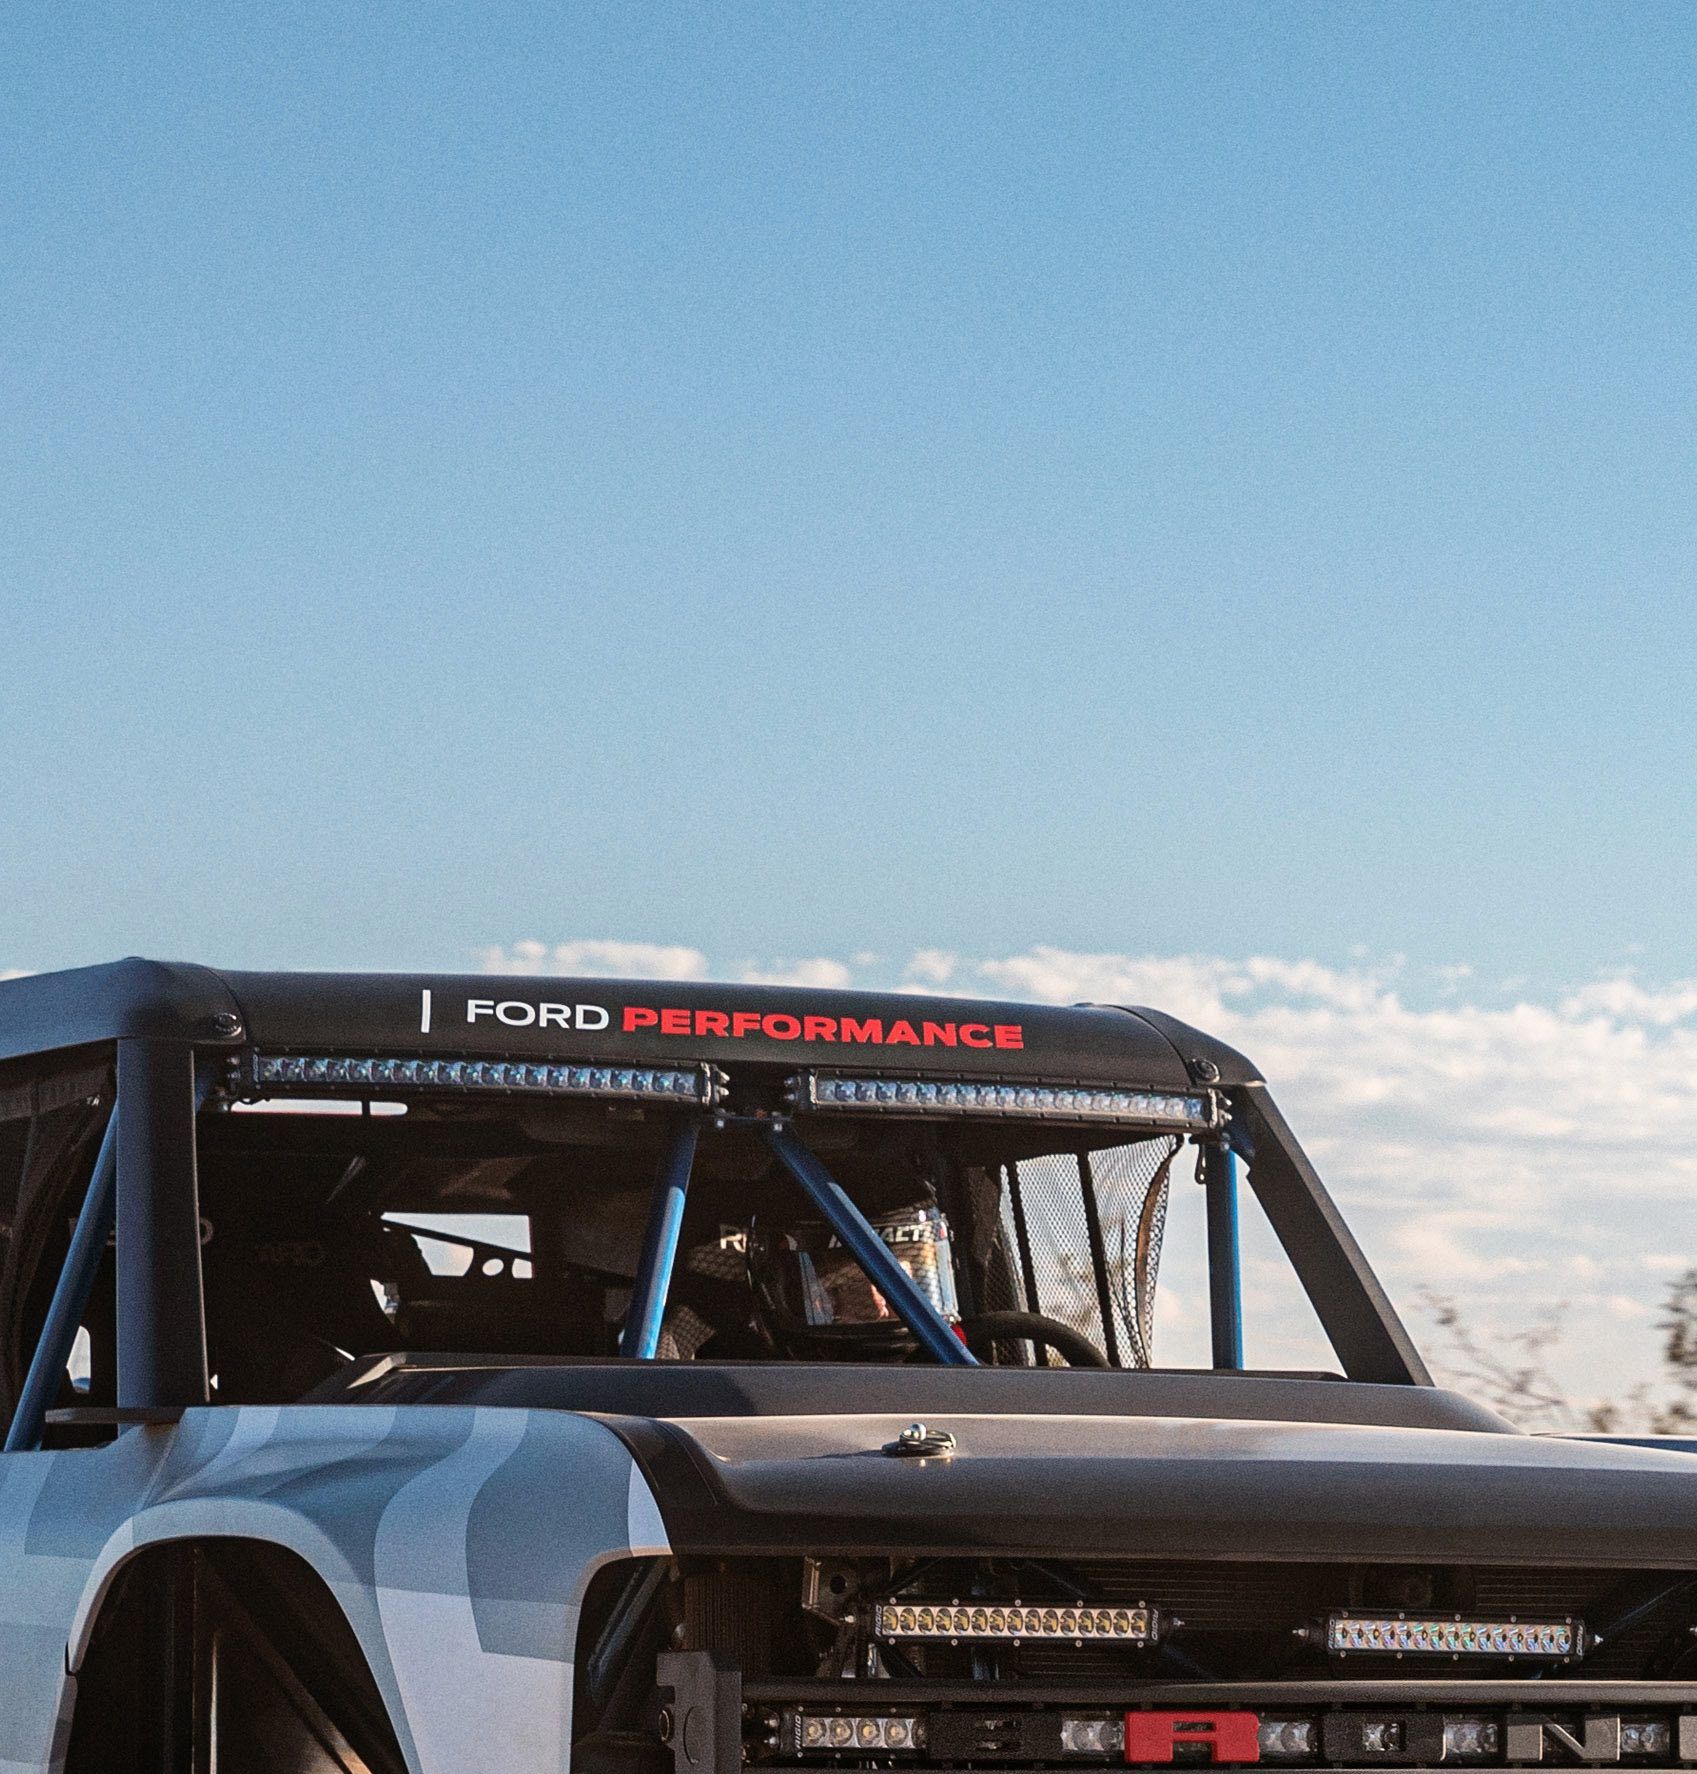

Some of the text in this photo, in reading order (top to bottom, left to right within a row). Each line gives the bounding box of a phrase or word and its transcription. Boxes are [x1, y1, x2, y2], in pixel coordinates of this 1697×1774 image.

[466, 998, 1025, 1050] FORD PERFORMANCE
[794, 1714, 802, 1750] RIGID
